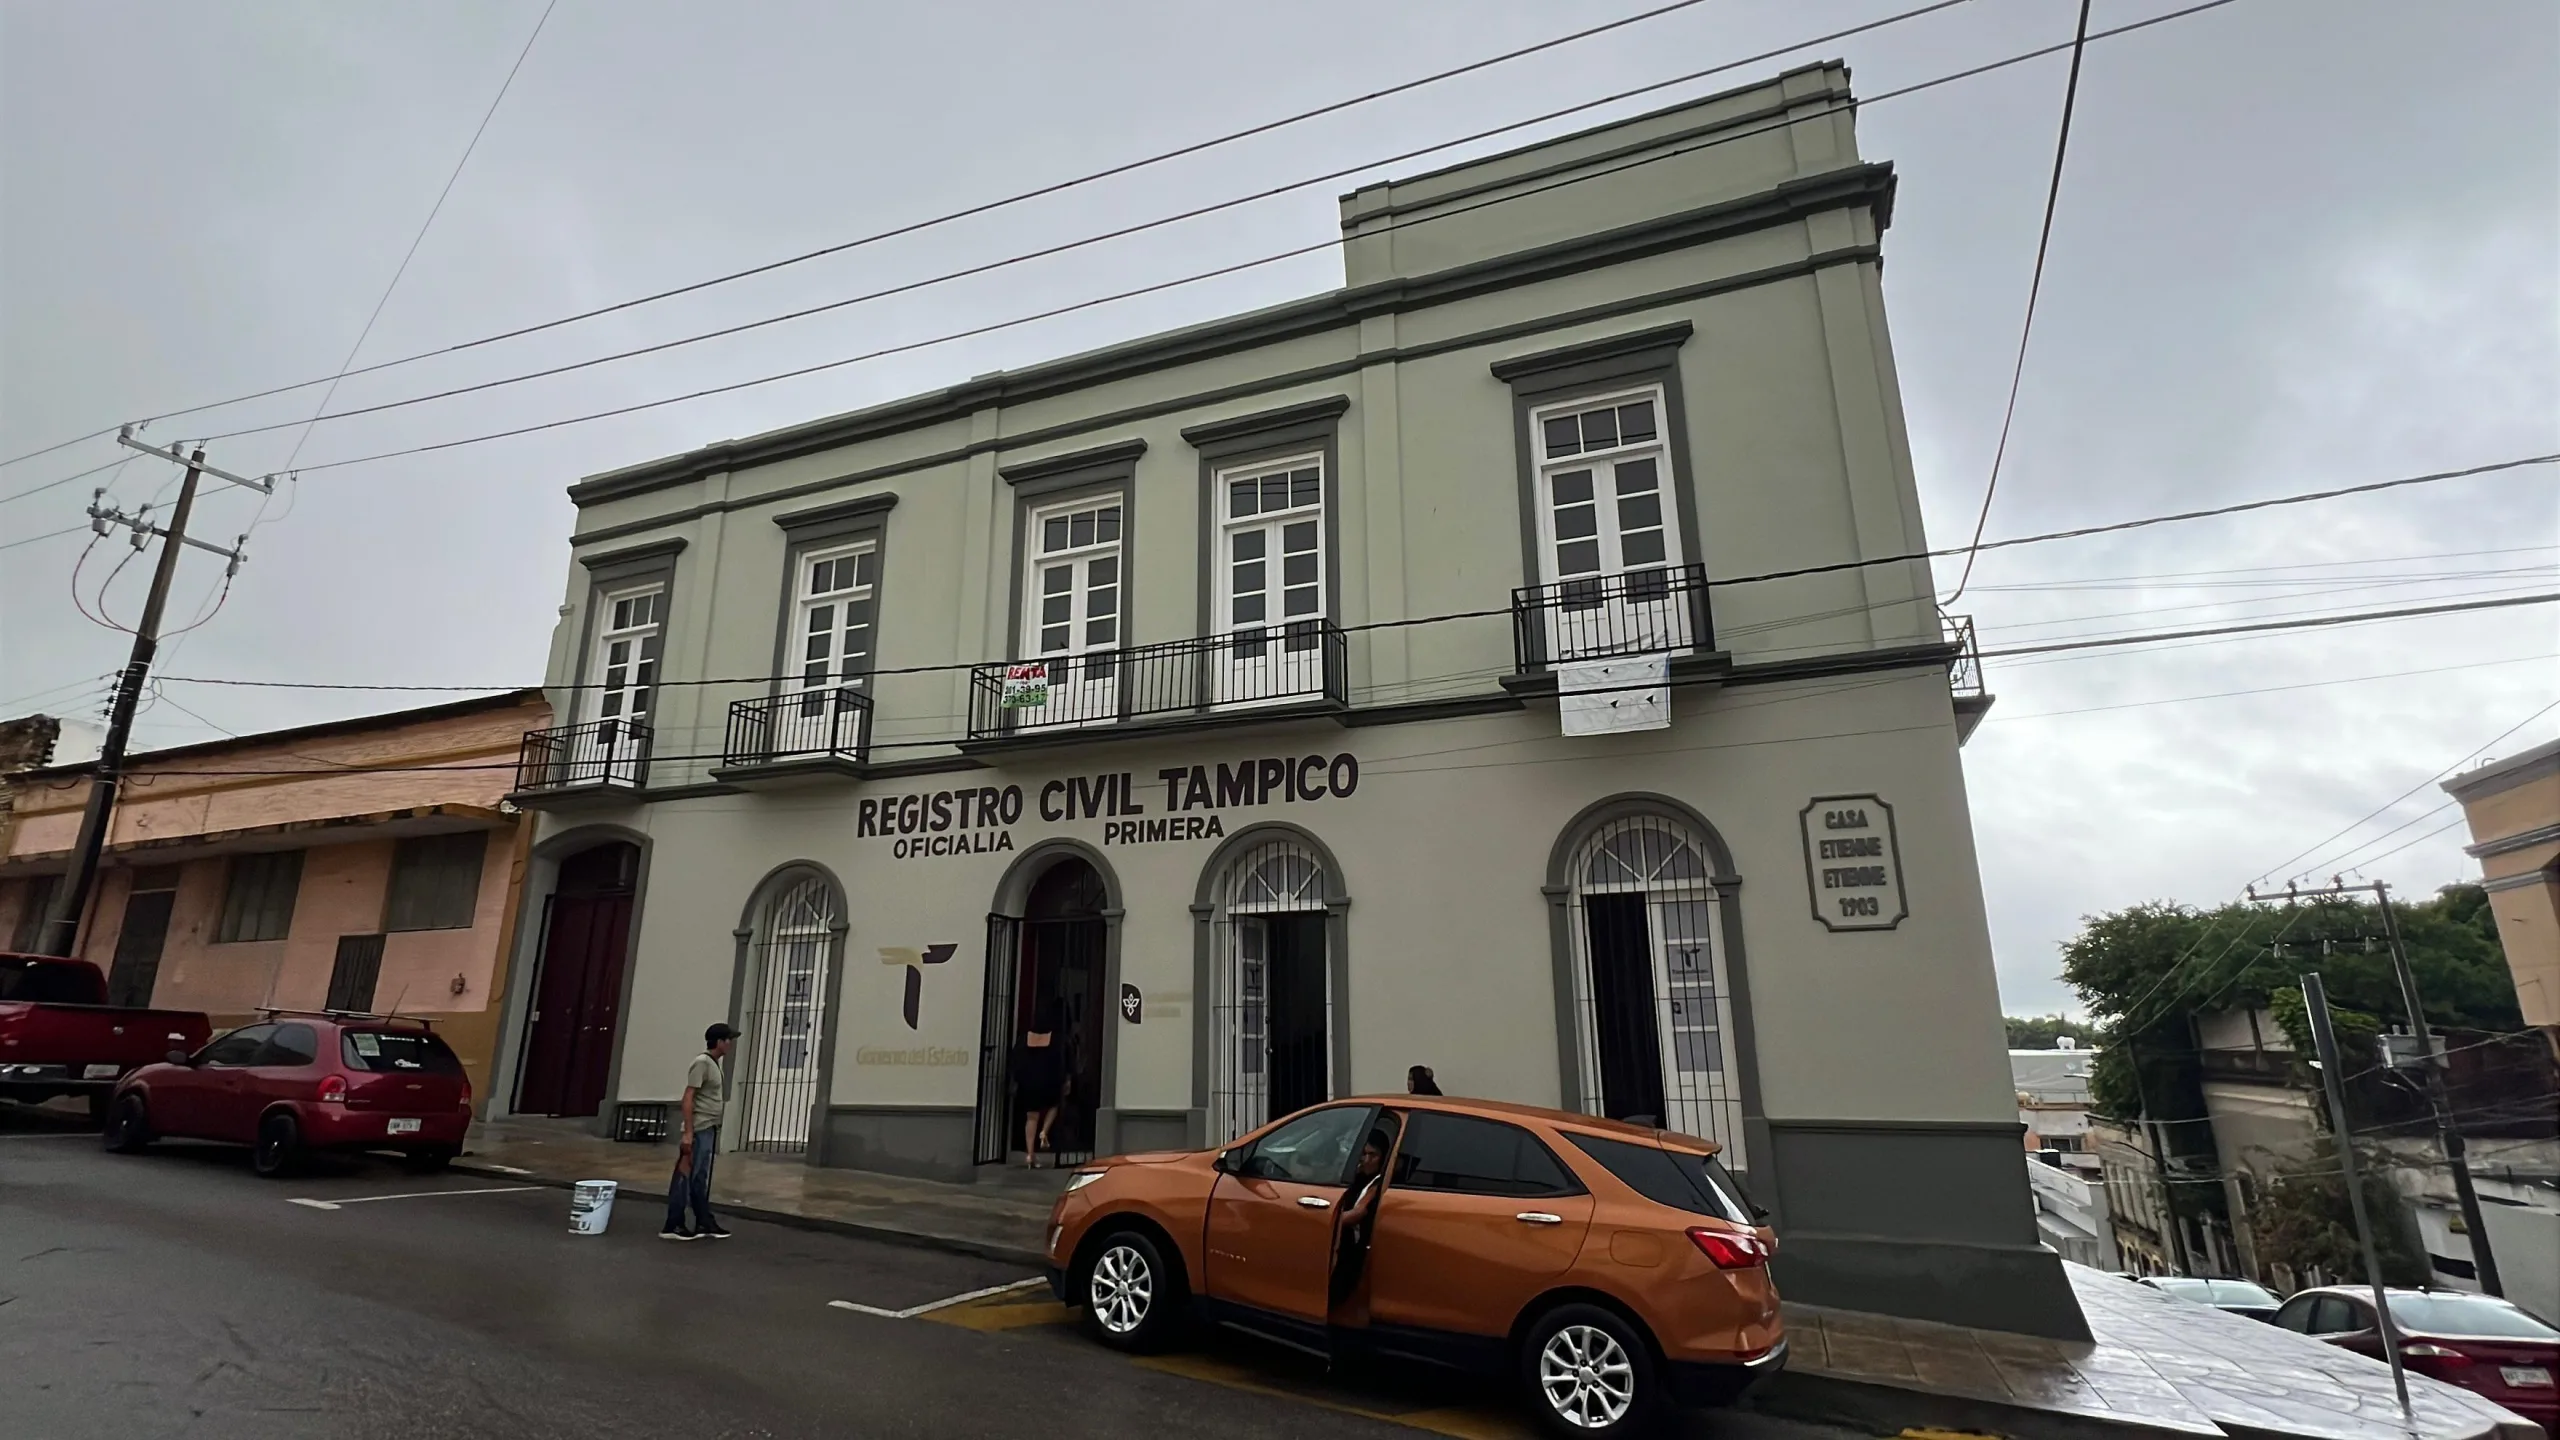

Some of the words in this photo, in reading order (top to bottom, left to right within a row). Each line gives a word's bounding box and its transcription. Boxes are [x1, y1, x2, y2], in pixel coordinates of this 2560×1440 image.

[1007, 665, 1047, 681] RENTA
[857, 784, 1024, 838] REGISTRO
[1039, 772, 1144, 822] CIVIL
[1158, 752, 1359, 812] TAMPICO
[1825, 808, 1869, 829] CASA
[893, 830, 1014, 859] OFICIALIA
[1104, 815, 1224, 846] PRIMERA
[1819, 837, 1882, 859] ETIENNE
[1838, 897, 1879, 917] 1903
